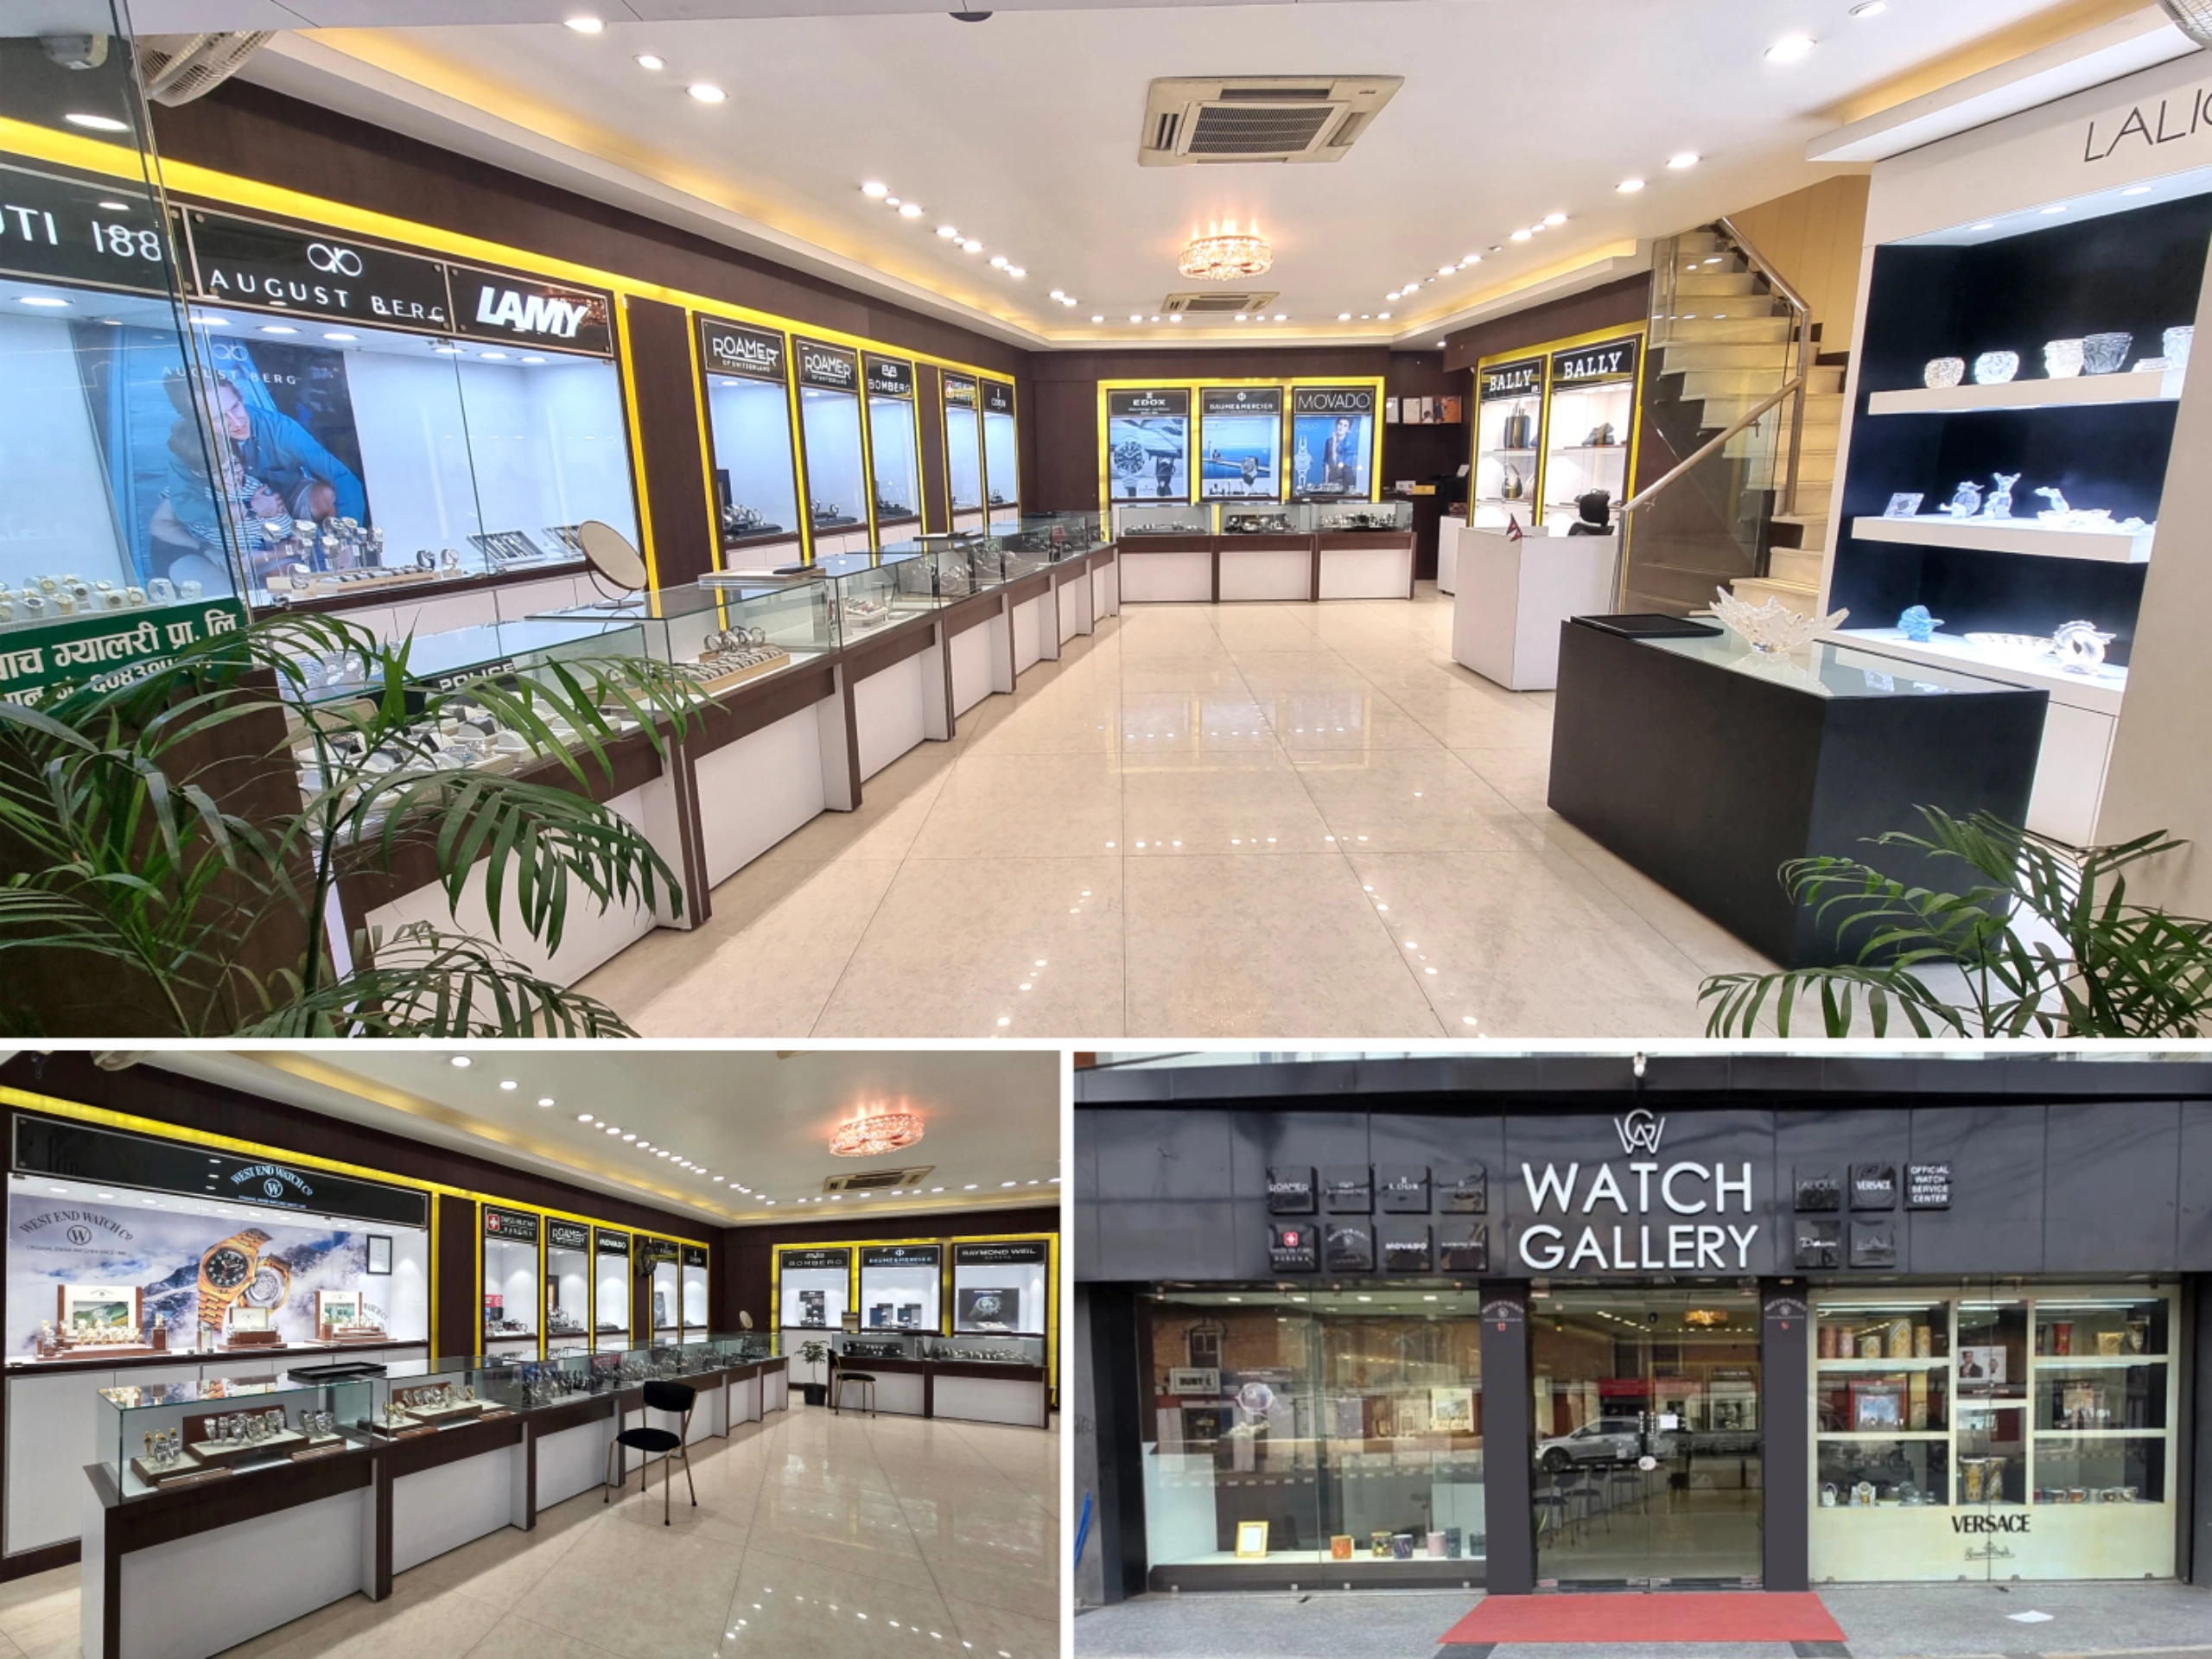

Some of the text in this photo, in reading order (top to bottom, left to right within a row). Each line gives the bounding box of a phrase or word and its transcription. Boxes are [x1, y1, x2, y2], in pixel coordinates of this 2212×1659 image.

[2084, 88, 2212, 162] LALI
[0, 203, 58, 245] TI
[210, 269, 444, 322] AUGUST BERG
[475, 285, 592, 338] LAMY
[712, 335, 780, 367] ROAMER
[804, 353, 852, 380] ROAMER
[1563, 351, 1623, 380] BALLY
[250, 372, 296, 385] BERG
[868, 378, 912, 392] BOMBERG
[1489, 368, 1533, 392] BALLY
[1298, 393, 1370, 410] MOVADO
[230, 1166, 256, 1185] WEST
[255, 1165, 274, 1176] END
[276, 1166, 304, 1188] WATCH
[1910, 1166, 1949, 1174] OFFICIAL
[1915, 1175, 1945, 1184] WATCH
[1521, 1161, 1752, 1214] WATCH
[1855, 1179, 1891, 1191] VERSACE
[1912, 1184, 1949, 1193] SERVICE
[1913, 1194, 1948, 1203] CENTER
[19, 1213, 54, 1234] WEST
[53, 1211, 80, 1223] END
[82, 1211, 121, 1234] WATCH
[1519, 1224, 1758, 1270] GALLERY
[1951, 1514, 2031, 1533] VERSACE
